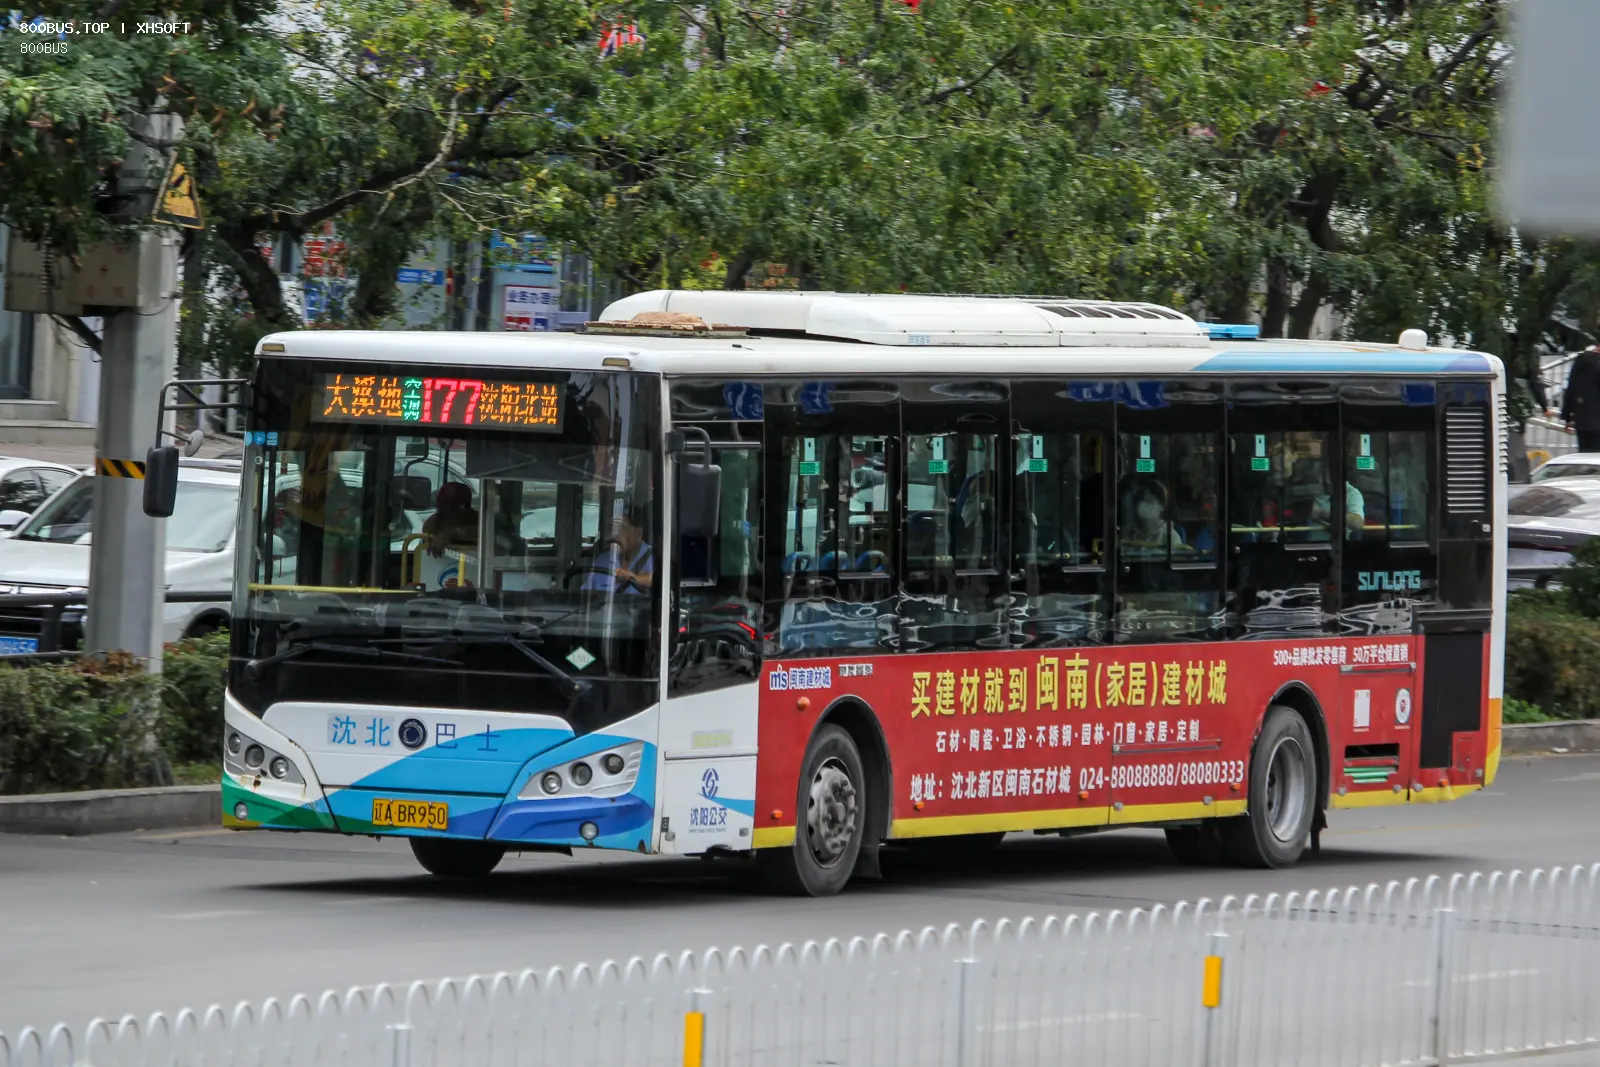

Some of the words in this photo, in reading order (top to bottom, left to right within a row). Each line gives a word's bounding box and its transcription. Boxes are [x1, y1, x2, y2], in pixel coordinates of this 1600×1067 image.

[421, 379, 483, 424] 177
[1358, 570, 1421, 591] SUNLONG
[788, 666, 832, 690] 闽南建材城
[331, 716, 391, 747] 沈北
[435, 723, 501, 752] 巴士
[1079, 759, 1245, 791] 024-88088888/88080333
[690, 807, 728, 826] 沈阳公交
